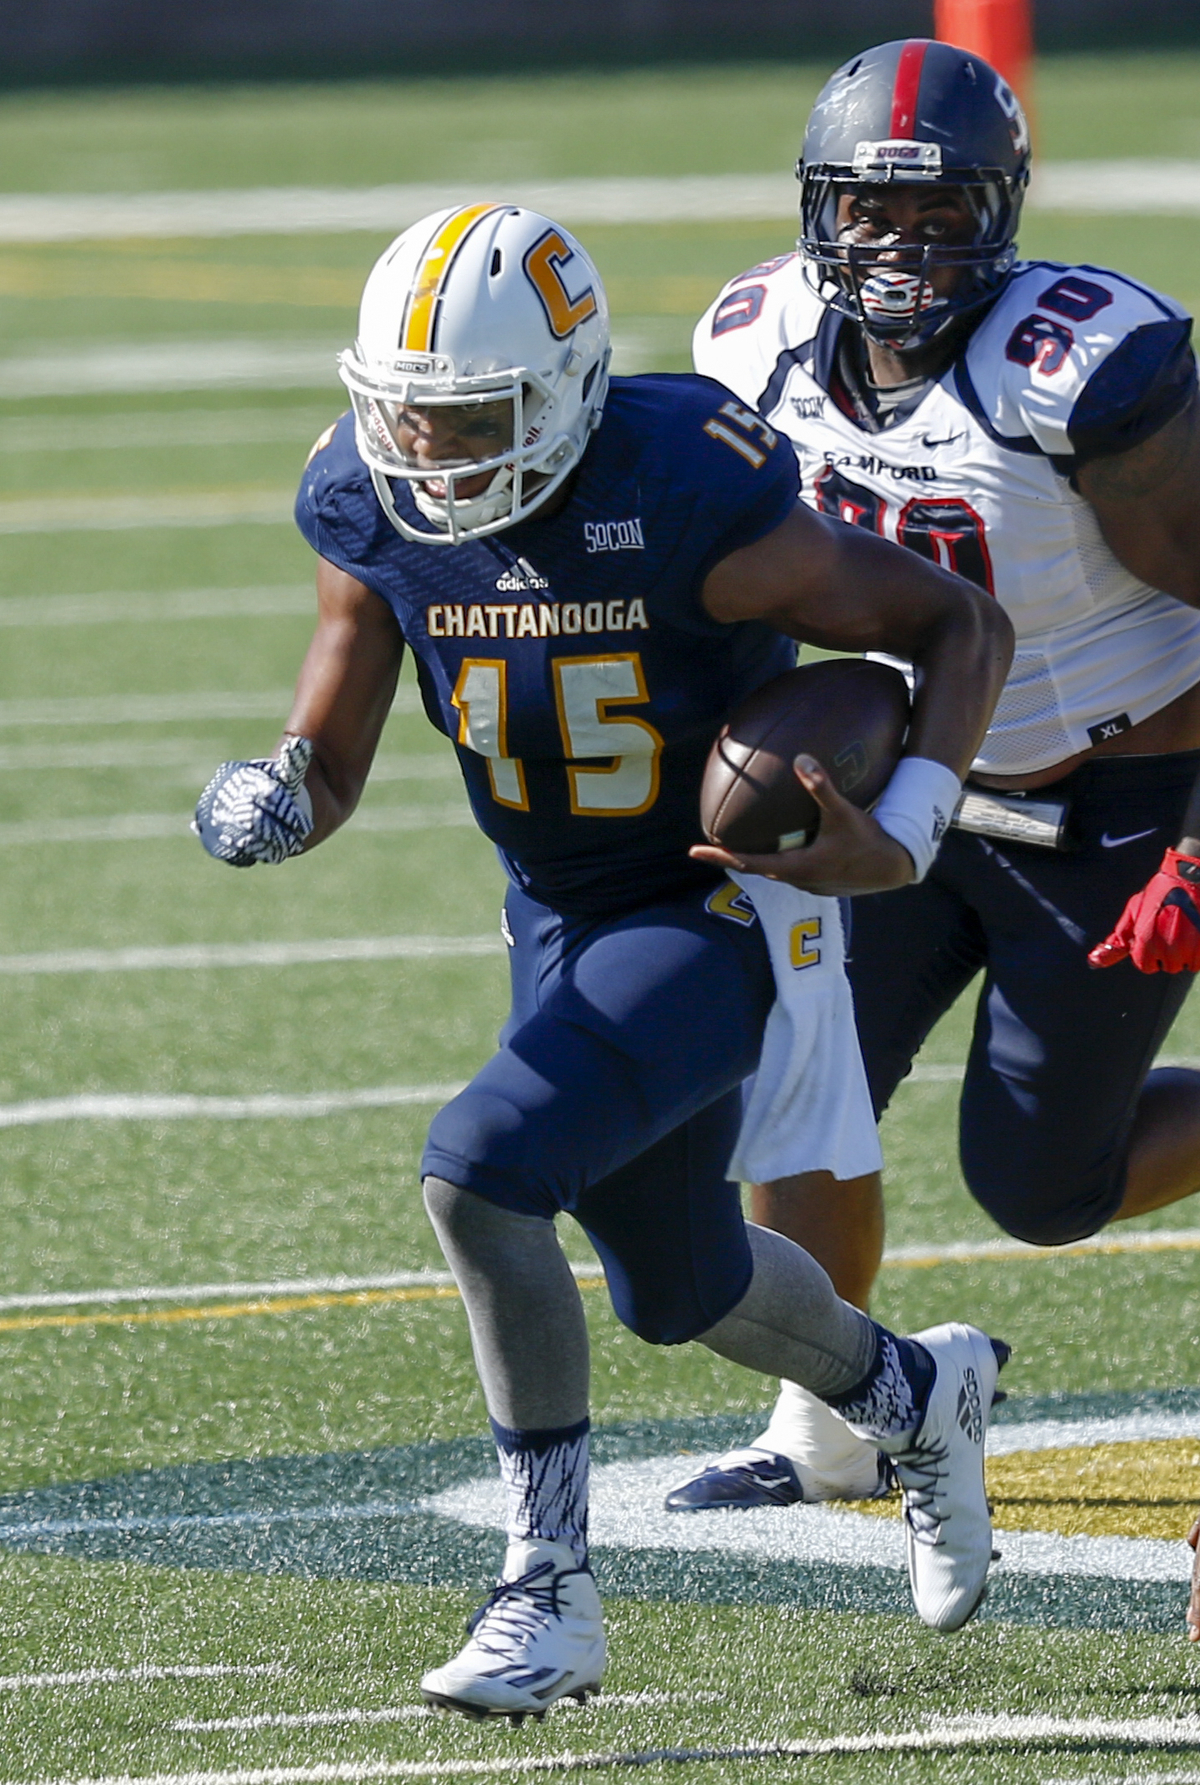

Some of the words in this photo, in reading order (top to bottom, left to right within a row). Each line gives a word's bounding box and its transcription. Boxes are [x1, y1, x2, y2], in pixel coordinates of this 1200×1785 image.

[876, 146, 921, 159] DOGS
[522, 228, 597, 341] C
[1005, 276, 1113, 377] 90
[394, 360, 430, 374] MOCS
[703, 401, 779, 470] 15
[584, 517, 646, 553] SOCON
[495, 576, 550, 592] adidas
[427, 598, 650, 639] CHATTANOOGA
[450, 652, 666, 818] 15
[1099, 722, 1124, 740] XL
[790, 917, 823, 971] C
[963, 1366, 983, 1444] adidas
